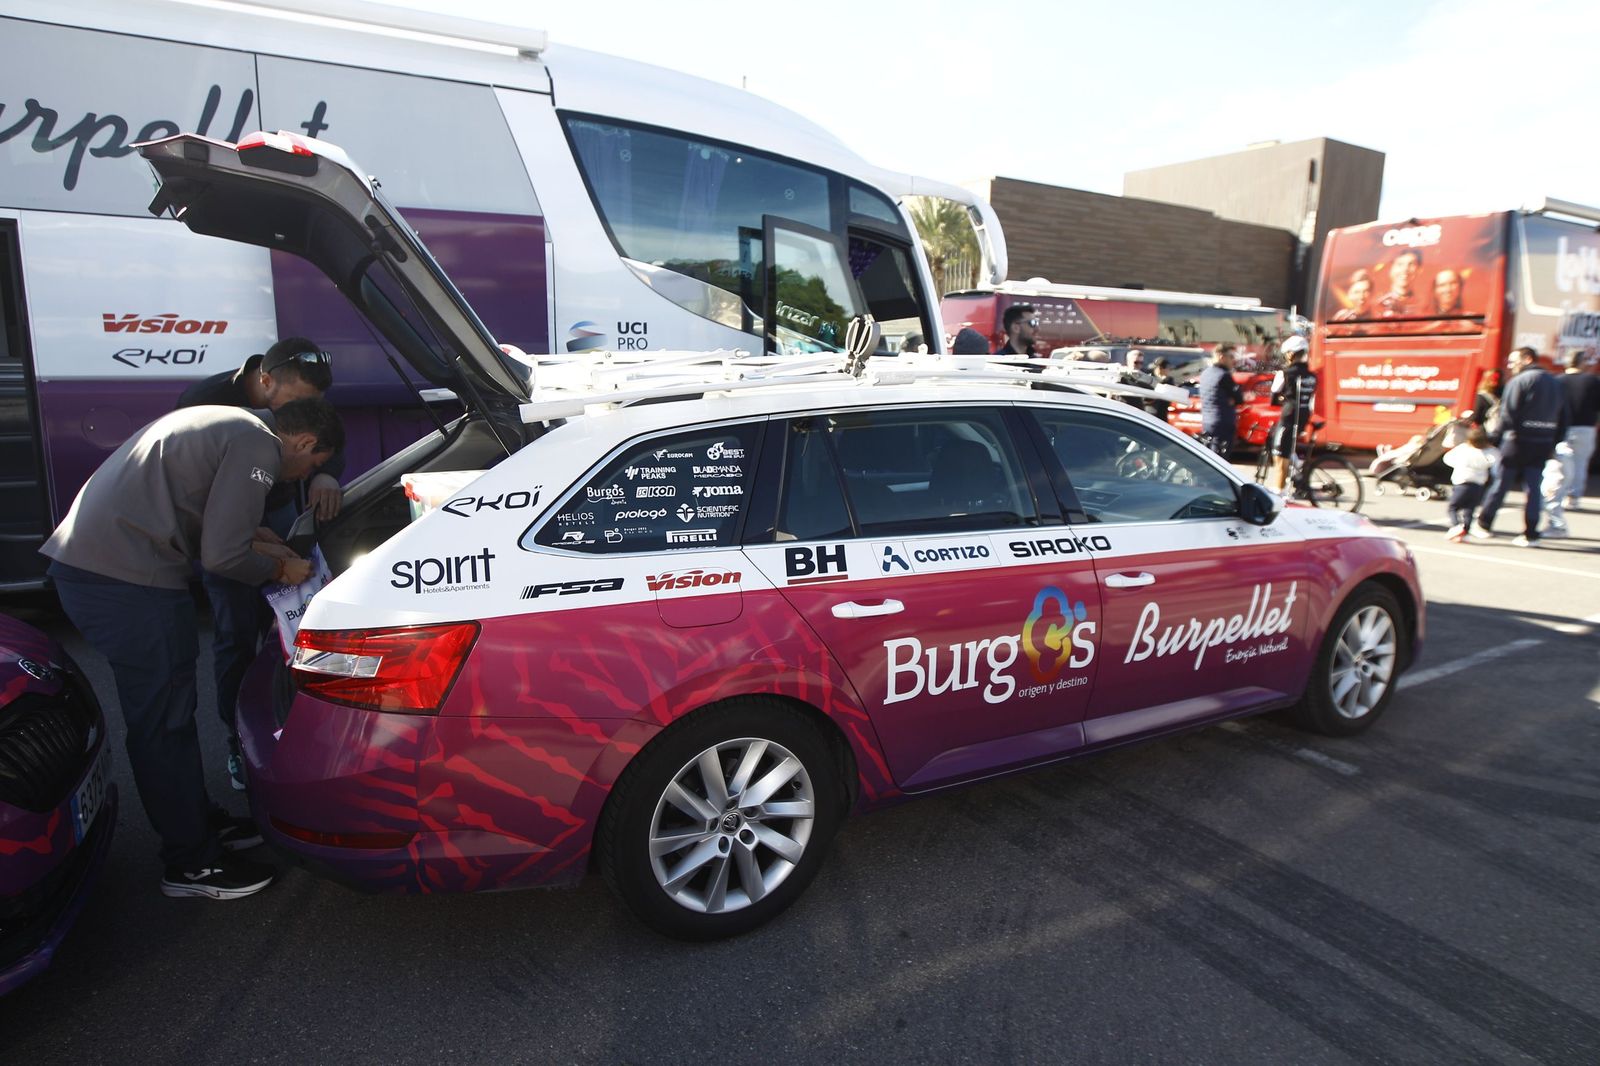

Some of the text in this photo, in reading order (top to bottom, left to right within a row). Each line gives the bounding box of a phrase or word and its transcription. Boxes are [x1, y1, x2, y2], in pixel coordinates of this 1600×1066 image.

[102, 313, 228, 334] Vision
[617, 321, 648, 335] UCI
[617, 337, 648, 350] PRO
[640, 466, 676, 474] TRAINING
[641, 472, 666, 480] PEAKS
[586, 484, 625, 499] Burgos
[556, 512, 595, 521] HELIOS
[614, 508, 667, 521] prologo
[665, 528, 718, 544] PIRELLI
[913, 545, 990, 563] CORTIZO
[1008, 535, 1112, 558] SIROKO
[784, 544, 848, 577] BH
[645, 569, 742, 591] Vision
[423, 583, 490, 594] Hotels&Apartments
[1123, 580, 1298, 671] Burpellet
[1018, 675, 1088, 699] origen y destino
